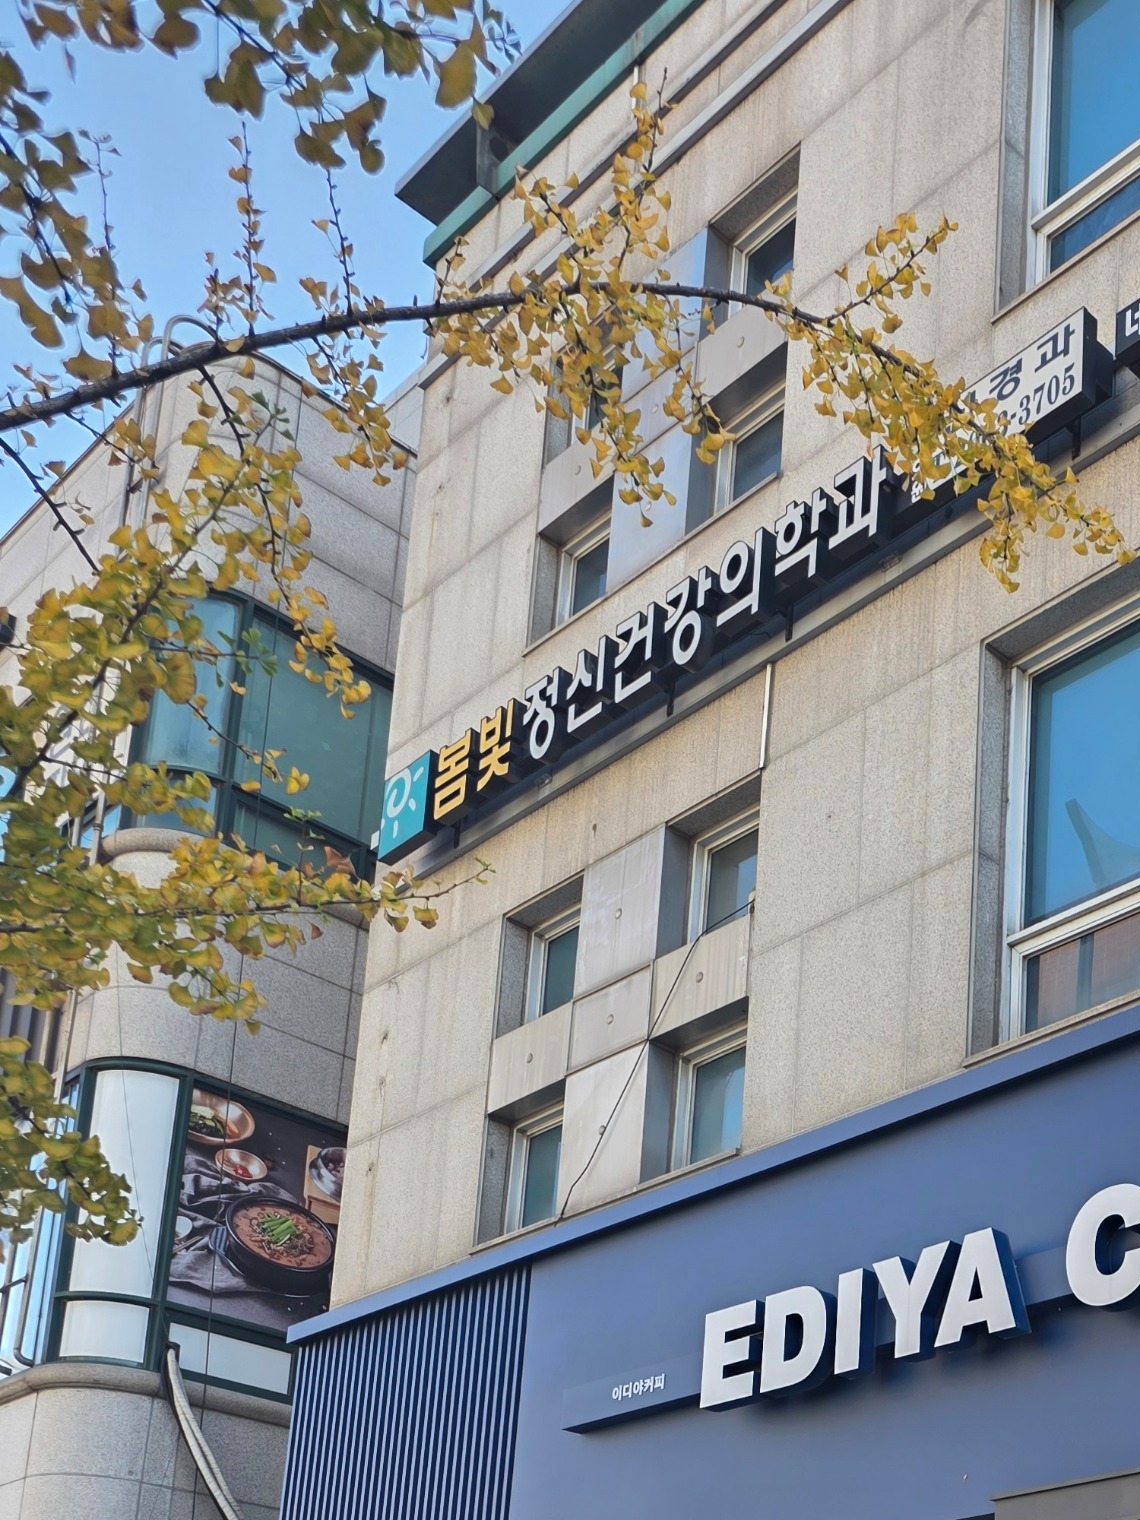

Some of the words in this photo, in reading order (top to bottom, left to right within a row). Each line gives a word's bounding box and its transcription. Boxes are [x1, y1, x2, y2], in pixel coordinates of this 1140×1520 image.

[434, 698, 512, 821] 봄빛
[523, 444, 887, 760] 정신건강의학과
[612, 1373, 666, 1401] 이디야커피
[700, 1227, 1018, 1410] EDIYA
